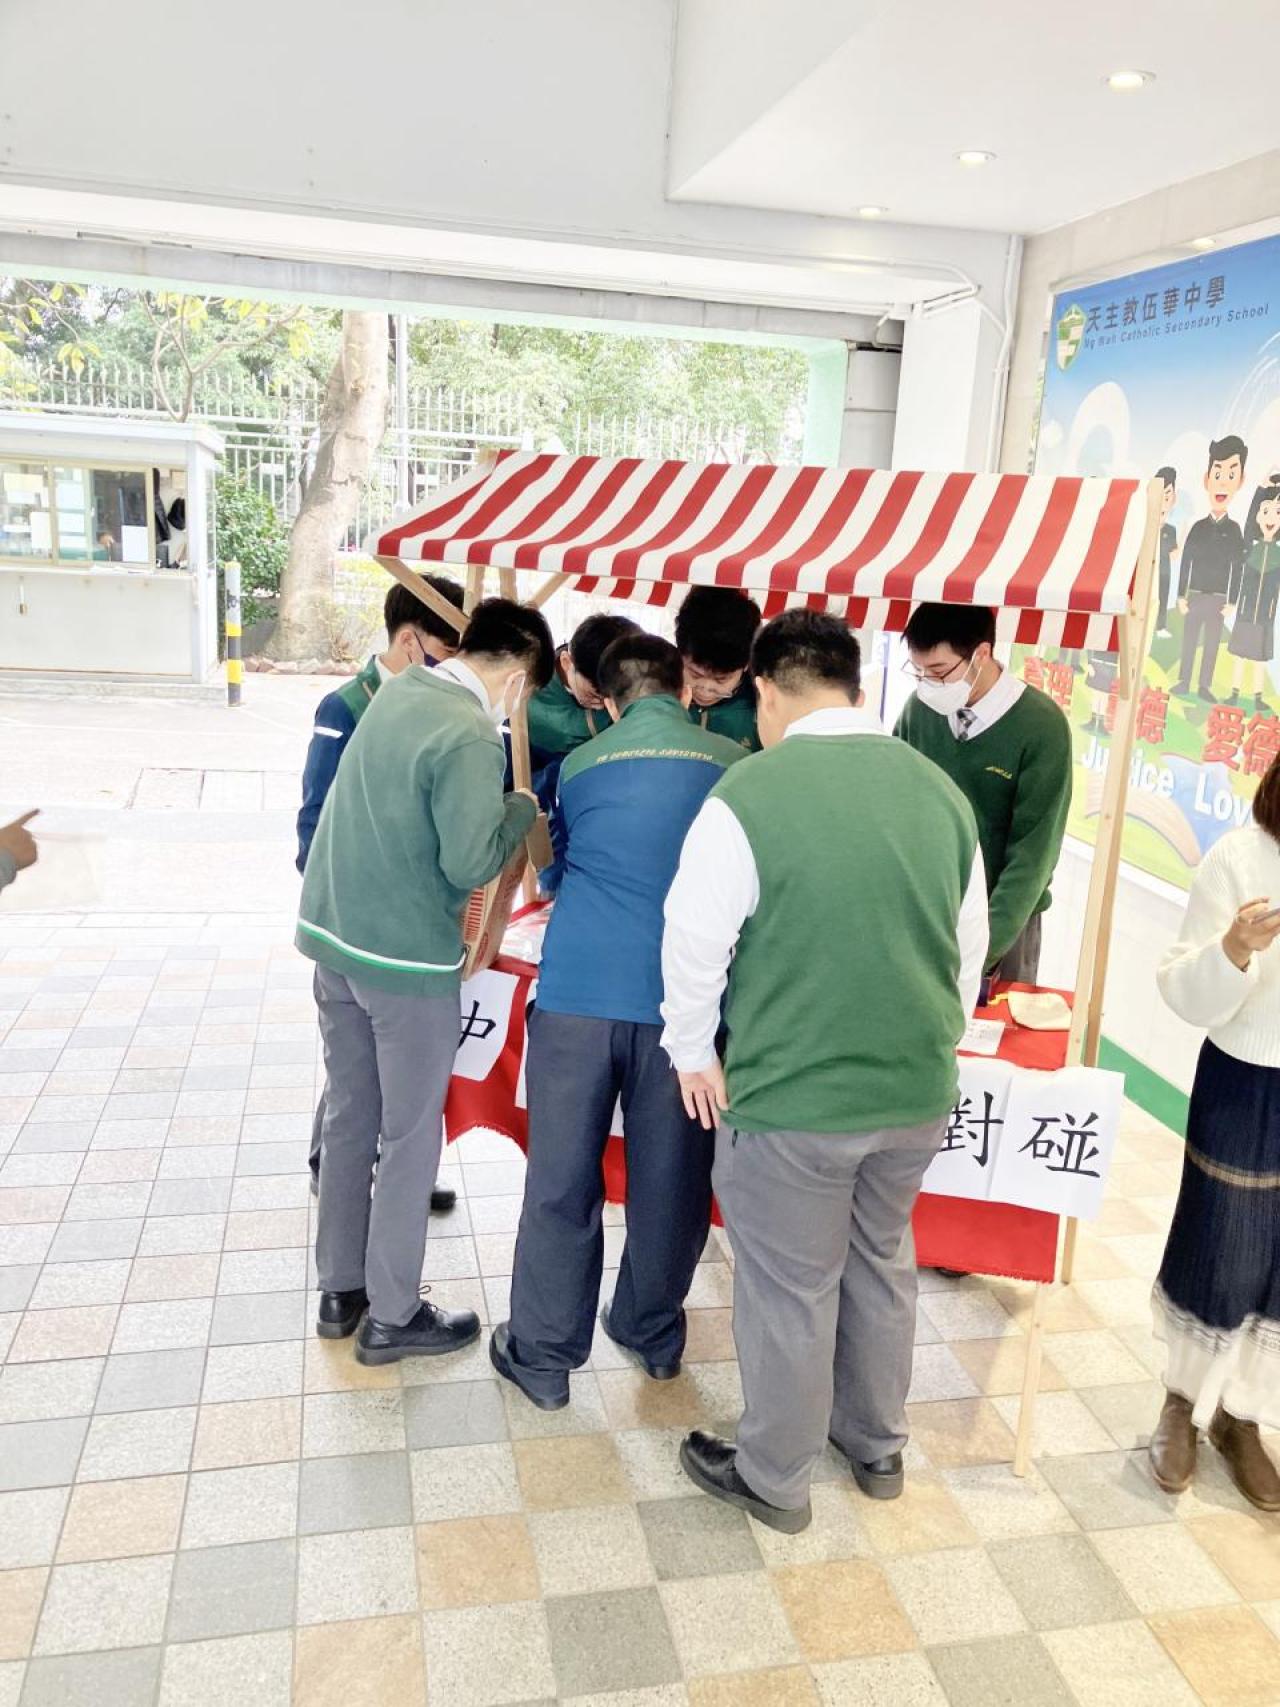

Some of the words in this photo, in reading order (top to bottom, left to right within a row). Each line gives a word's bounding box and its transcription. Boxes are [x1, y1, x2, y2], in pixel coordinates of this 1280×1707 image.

[1086, 275, 1226, 333] 天主教伍華中學
[1120, 326, 1161, 344] Catholic
[1165, 313, 1222, 334] Secondary
[1227, 303, 1269, 323] School
[1082, 736, 1175, 798] Juice
[1194, 772, 1252, 828] Lov
